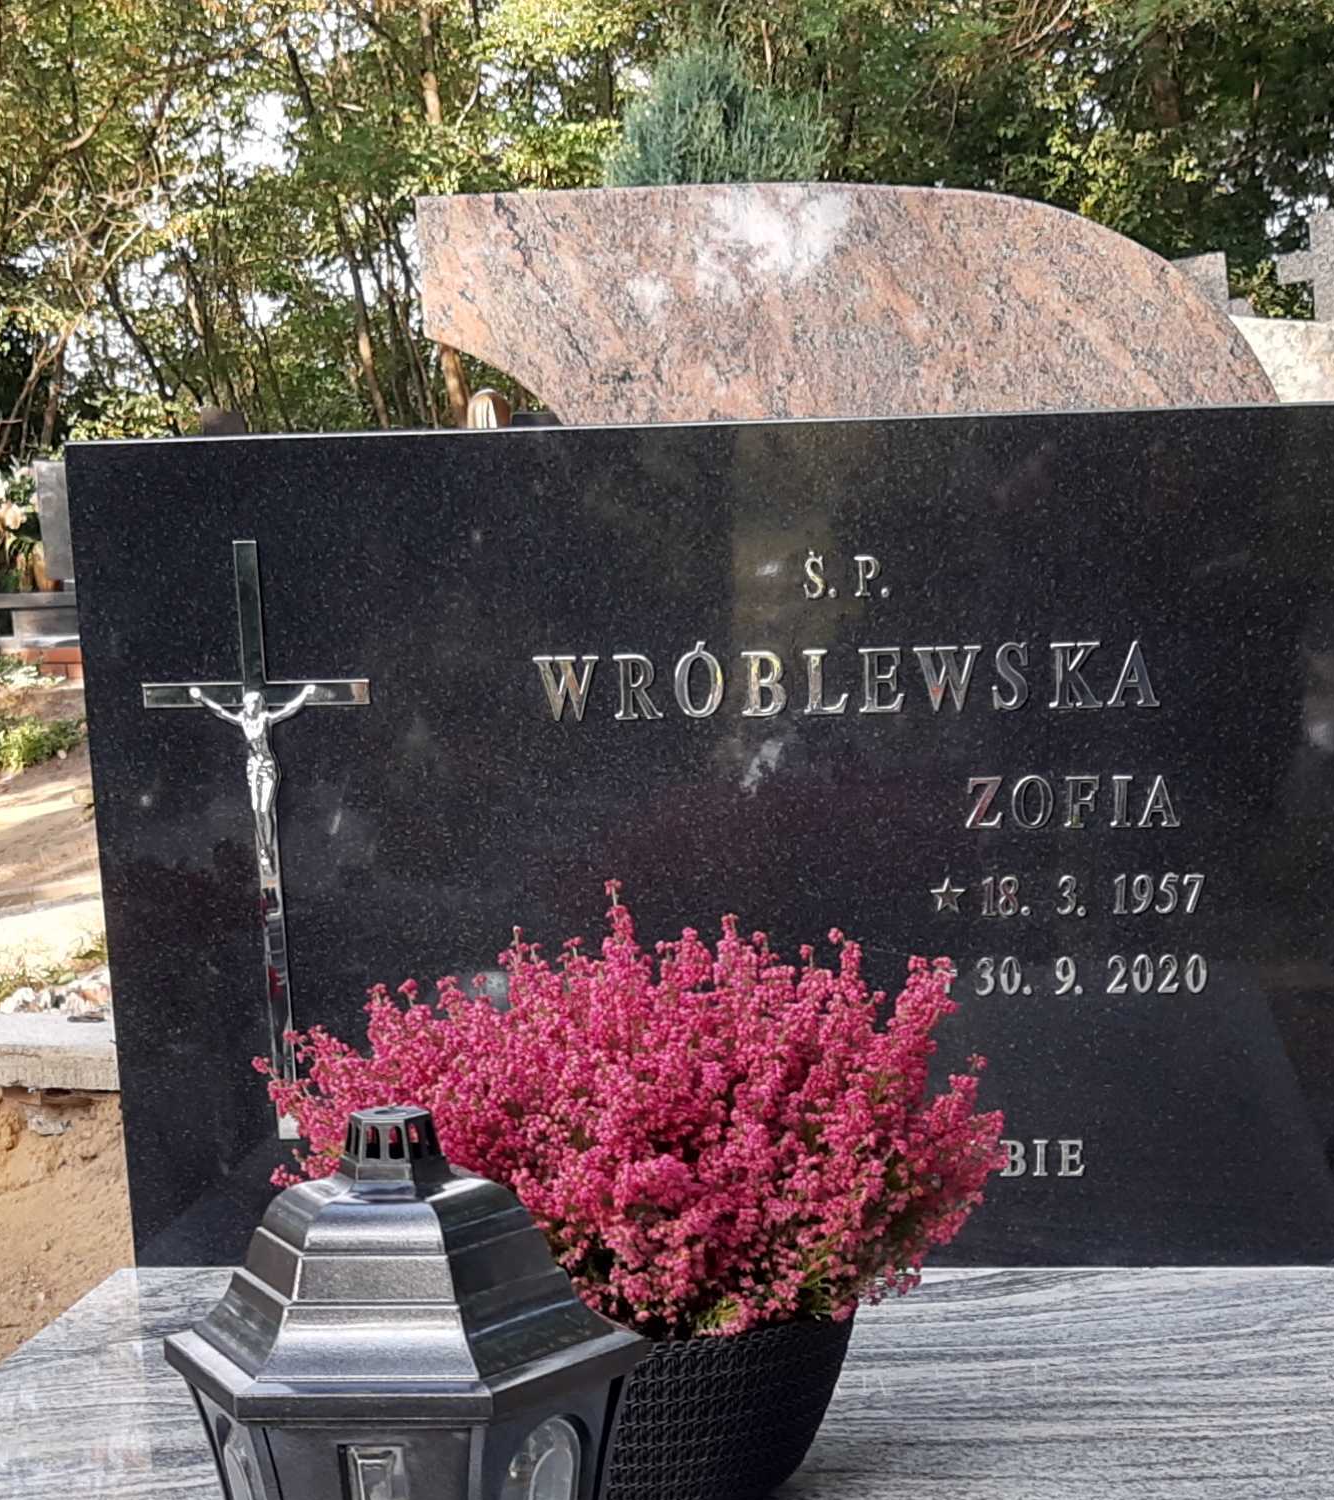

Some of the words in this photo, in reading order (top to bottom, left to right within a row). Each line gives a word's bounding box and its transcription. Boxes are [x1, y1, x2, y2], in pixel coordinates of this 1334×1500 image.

[853, 553, 891, 598] P.
[532, 641, 1160, 721] WRÓBLEWSKA
[965, 774, 1181, 829] ZOFIA
[980, 875, 1031, 917] 18.
[1056, 874, 1087, 917] 3.
[1112, 871, 1206, 915] 1957
[975, 955, 1033, 996] 30.
[1054, 955, 1084, 996] 9.
[1106, 953, 1209, 995] 2020
